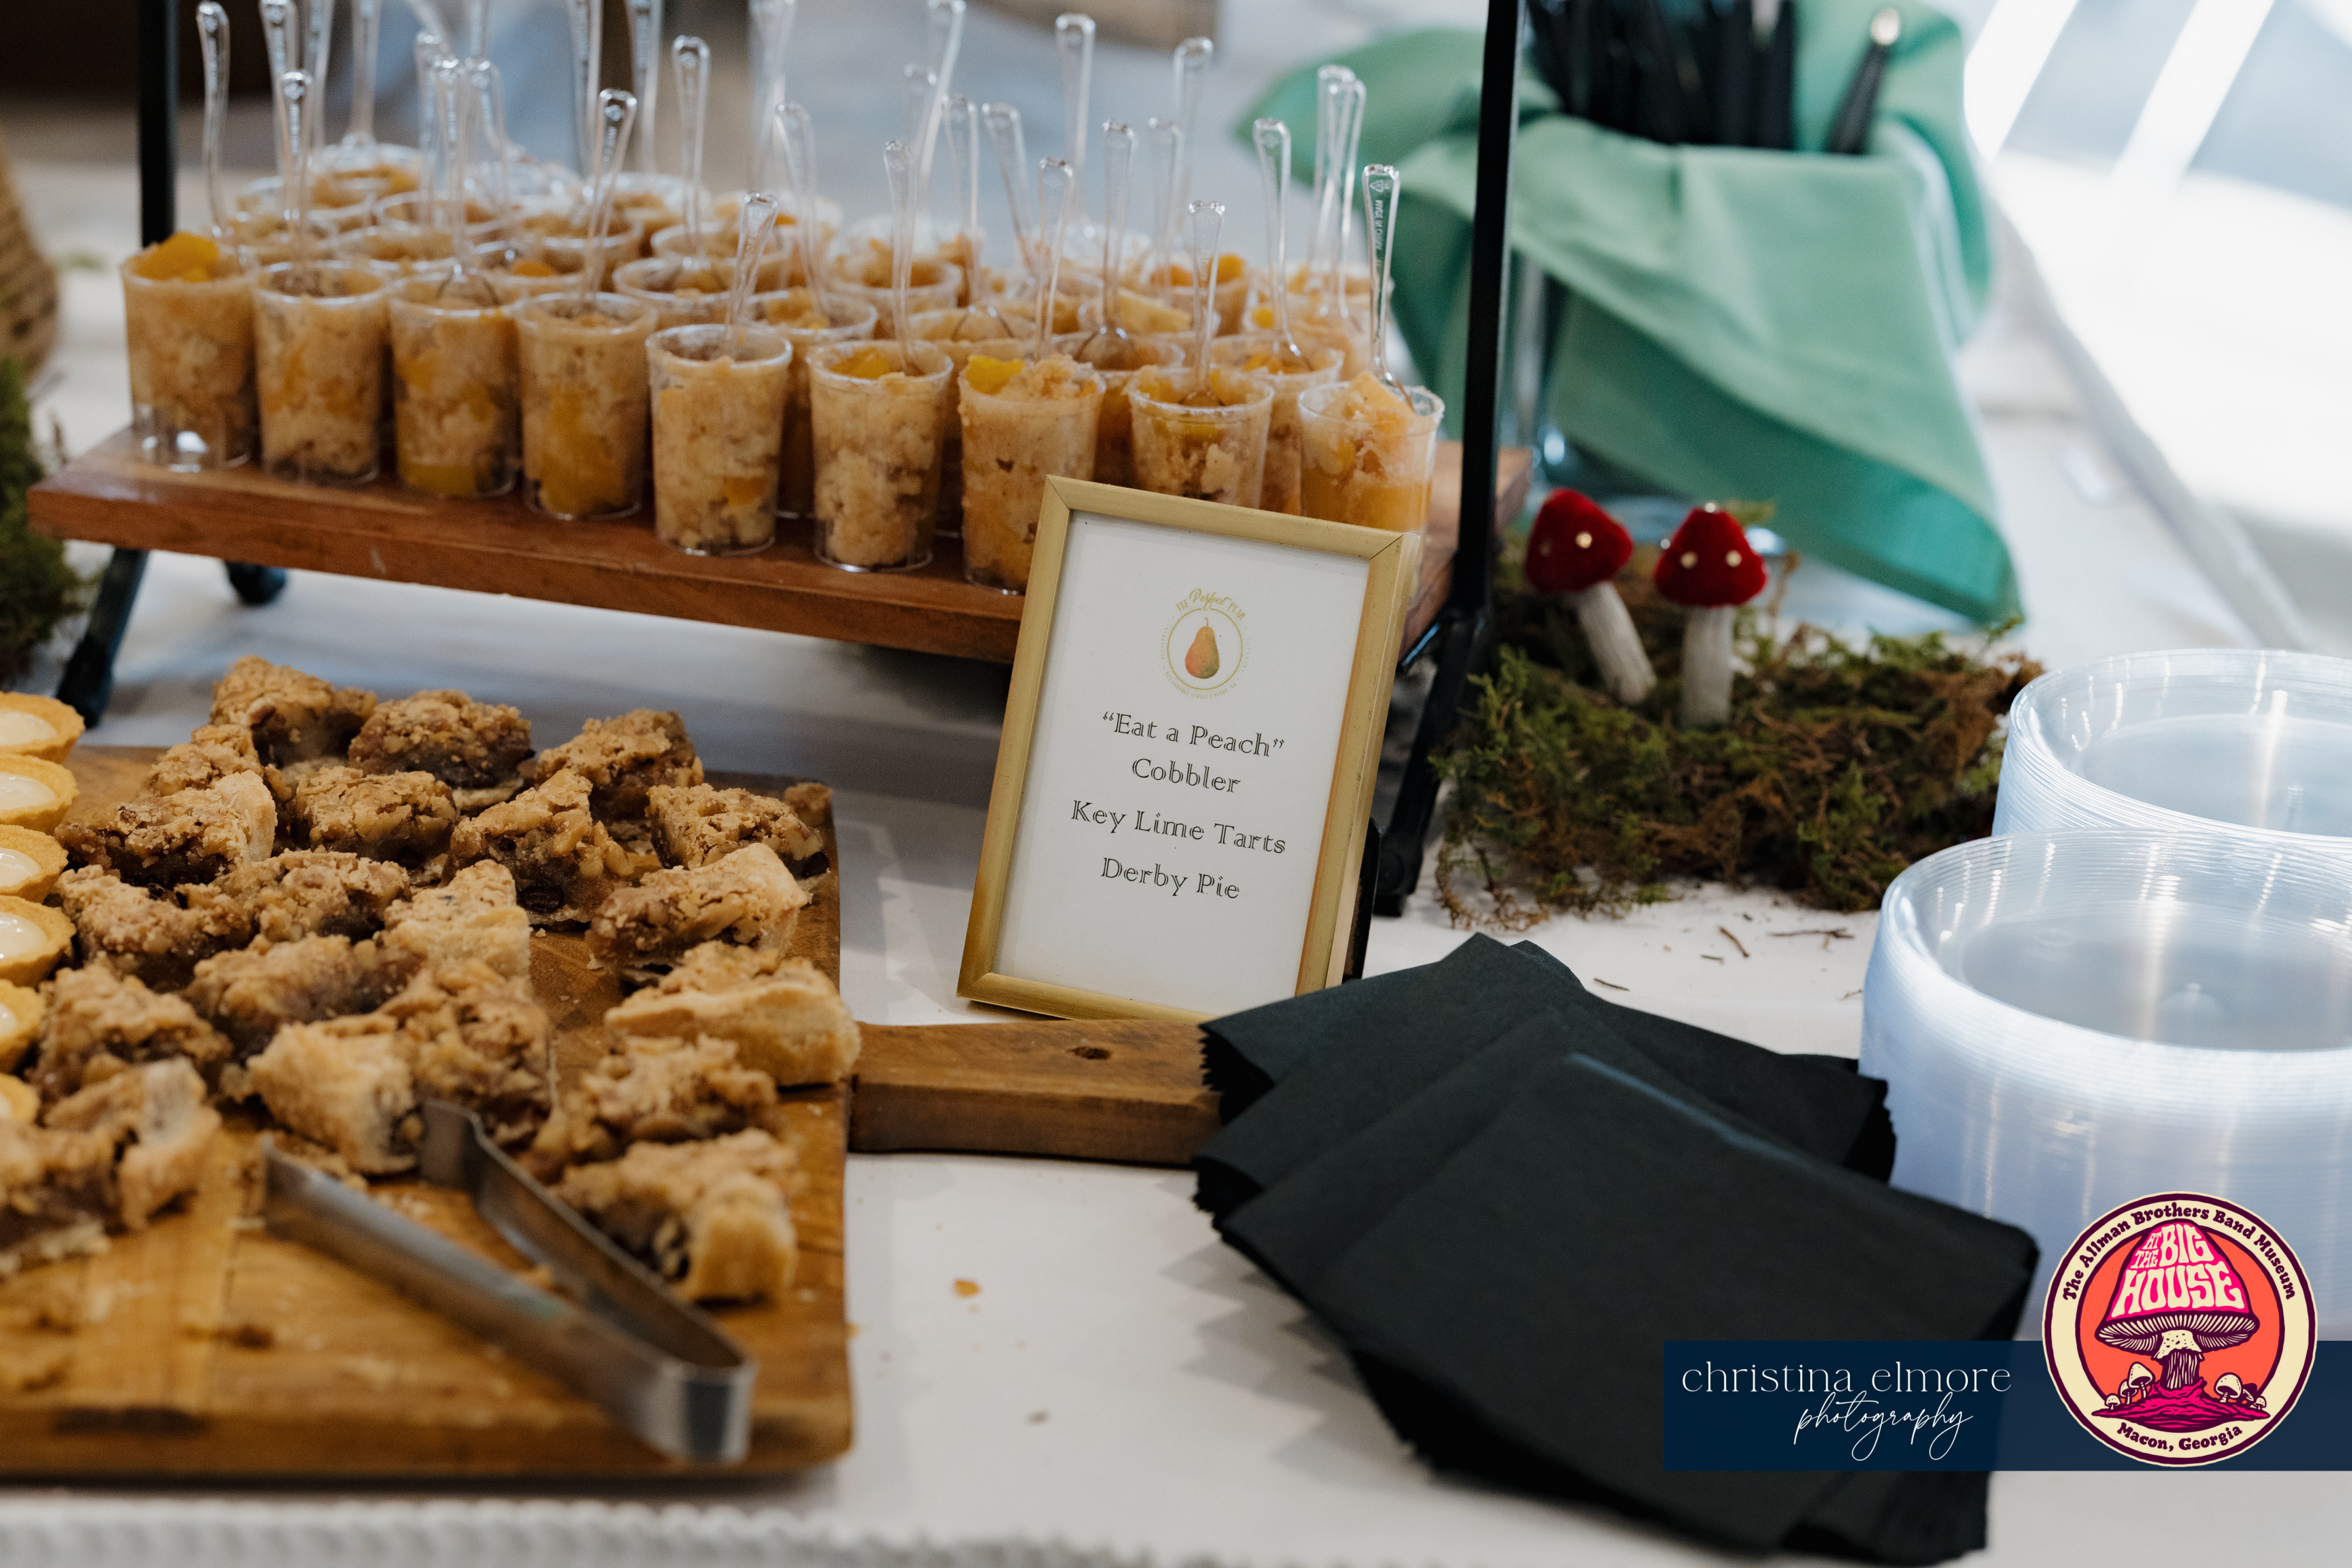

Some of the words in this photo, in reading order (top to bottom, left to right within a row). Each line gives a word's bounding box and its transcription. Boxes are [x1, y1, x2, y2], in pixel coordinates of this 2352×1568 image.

[1189, 588, 1232, 611] Perfect
[1227, 602, 1246, 621] PEAR
[1166, 728, 1179, 742] a
[1132, 758, 1241, 793] Cobbler
[1071, 800, 1127, 834] Key
[1134, 810, 1205, 840] Lime
[1213, 823, 1286, 854] Tarts
[1100, 857, 1189, 897] Derby
[1195, 873, 1240, 899] Pie
